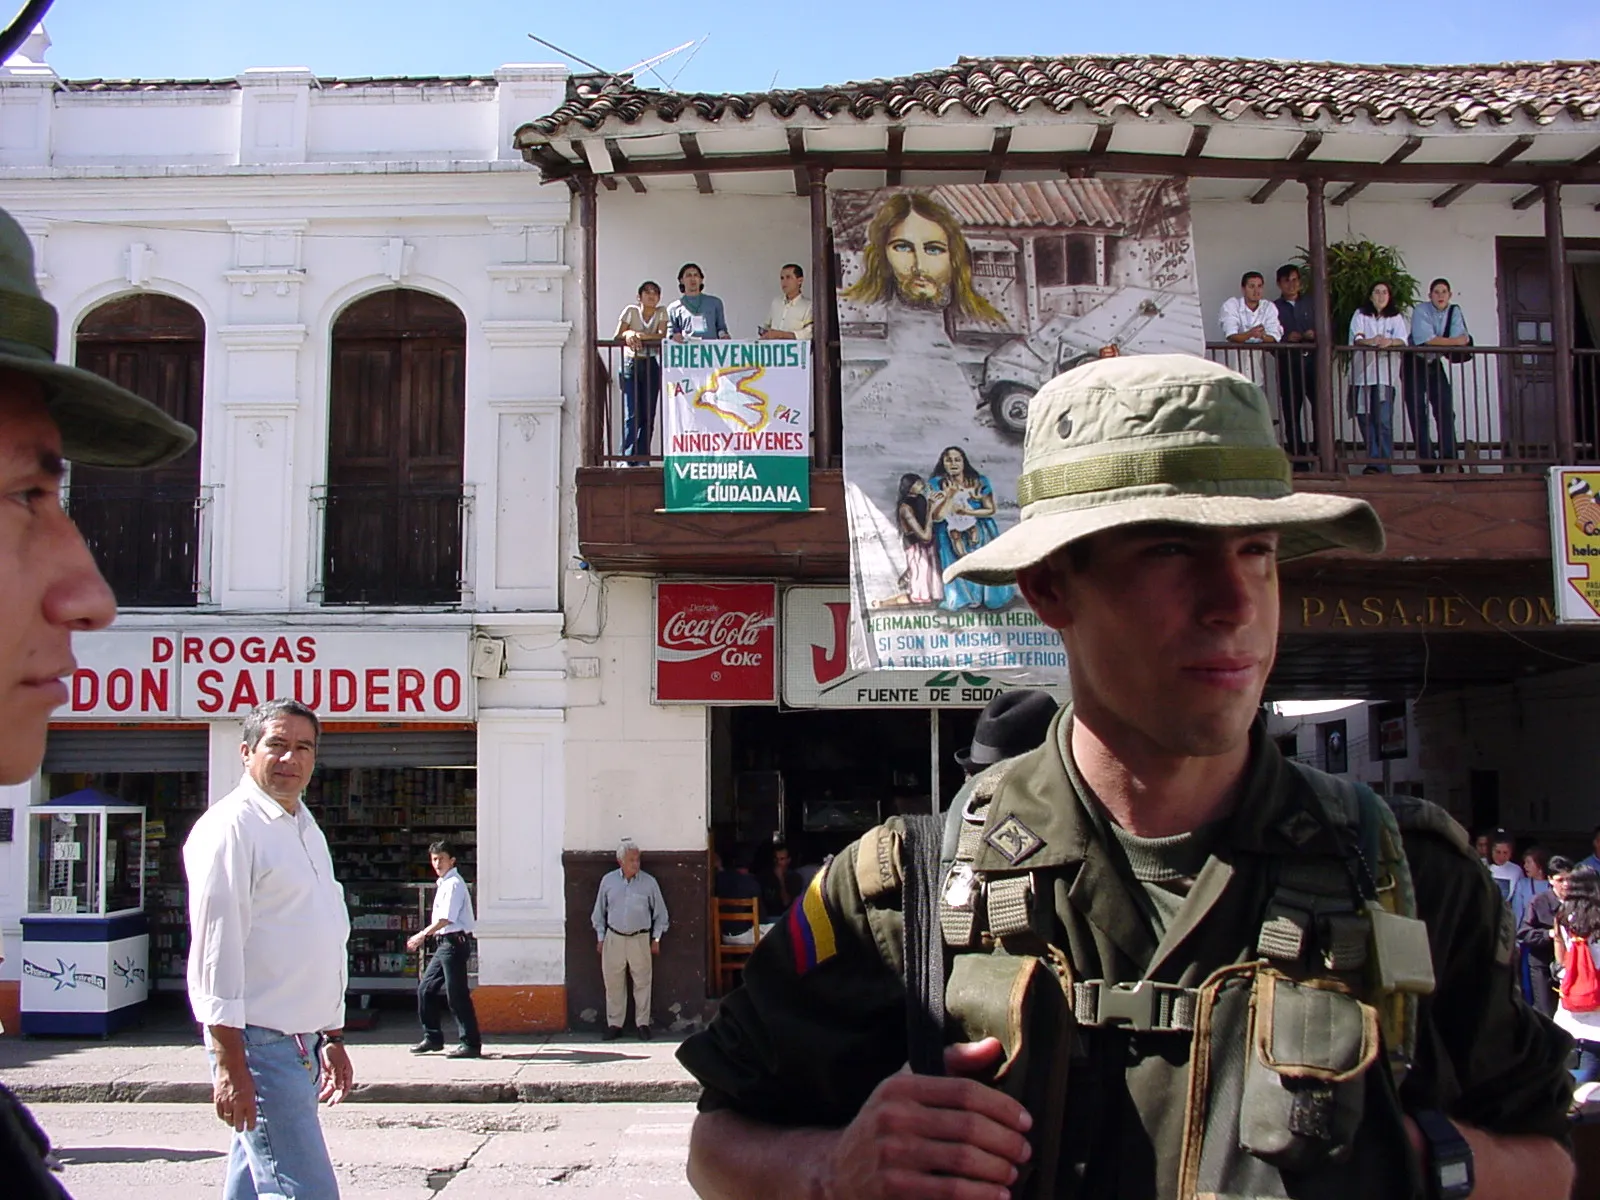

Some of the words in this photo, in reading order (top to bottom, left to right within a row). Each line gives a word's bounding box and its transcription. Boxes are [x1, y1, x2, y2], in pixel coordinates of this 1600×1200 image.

[667, 379, 693, 398] PAZ
[774, 404, 800, 424] PAZ
[707, 482, 802, 502] CIUDADANA
[1302, 597, 1466, 626] PASAJE
[663, 610, 762, 646] Coca-Cola
[867, 615, 941, 633] HERMANOS
[946, 612, 1004, 629] CONTRA
[152, 637, 317, 663] DROGAS
[879, 637, 891, 651] SI
[897, 634, 924, 651] SON
[930, 634, 949, 649] UN
[955, 632, 1001, 648] MISMO
[1006, 631, 1061, 647] PUEBLO
[721, 647, 763, 666] Coke
[956, 653, 973, 667] EN
[979, 651, 998, 667] SU
[1003, 651, 1067, 667] INTERIOR
[72, 668, 168, 712] DON
[198, 668, 461, 712] SALUDERO
[857, 688, 919, 702] FUENTE
[930, 688, 950, 701] DE
